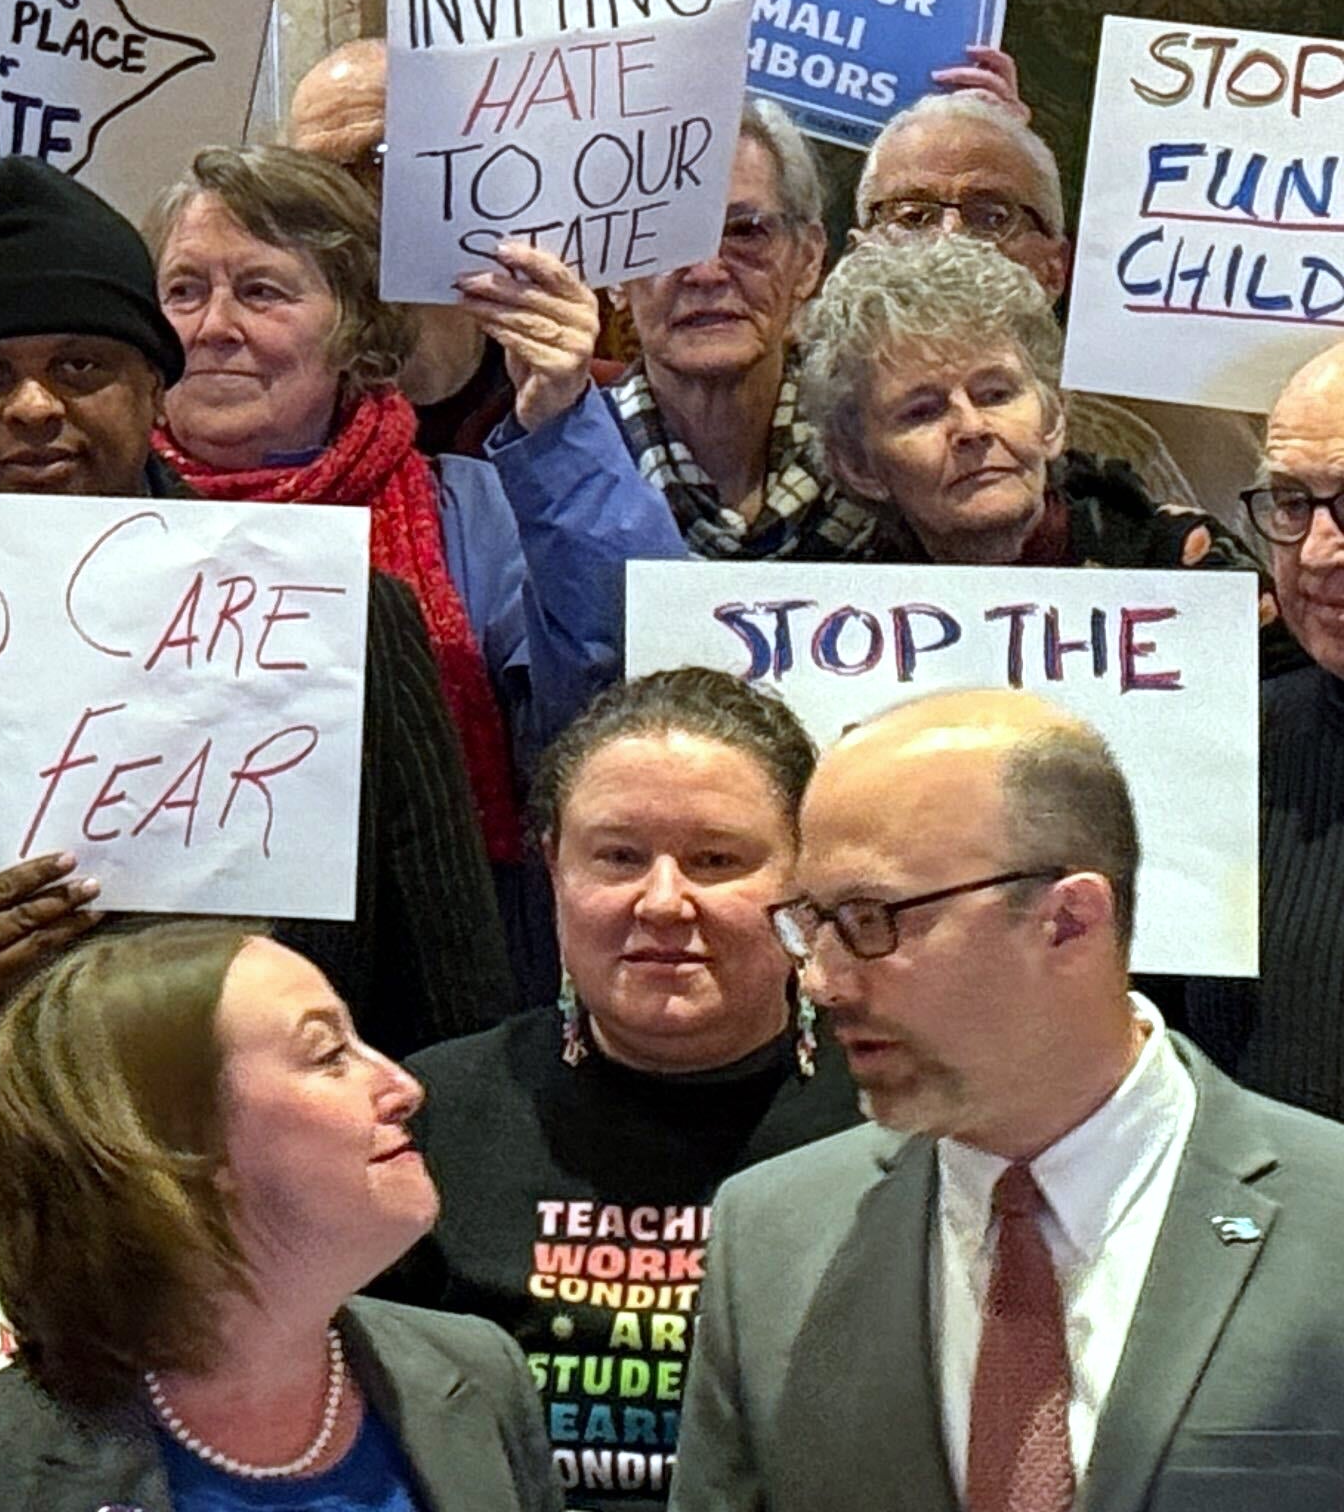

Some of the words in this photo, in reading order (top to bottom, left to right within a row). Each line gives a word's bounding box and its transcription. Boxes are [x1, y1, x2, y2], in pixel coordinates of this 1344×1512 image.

[11, 0, 149, 75] PLACE
[1129, 31, 1344, 119] STOP
[460, 35, 673, 137] HATE
[415, 142, 544, 221] TO
[573, 116, 713, 210] OUR
[65, 510, 348, 679] CARE
[712, 598, 964, 684] STOP
[983, 602, 1185, 695] THE
[18, 702, 319, 859] FEAR
[528, 1274, 700, 1312] CONDIT
[533, 1242, 706, 1281] WORK
[609, 1311, 687, 1353] AR
[527, 1353, 685, 1401] STUDE
